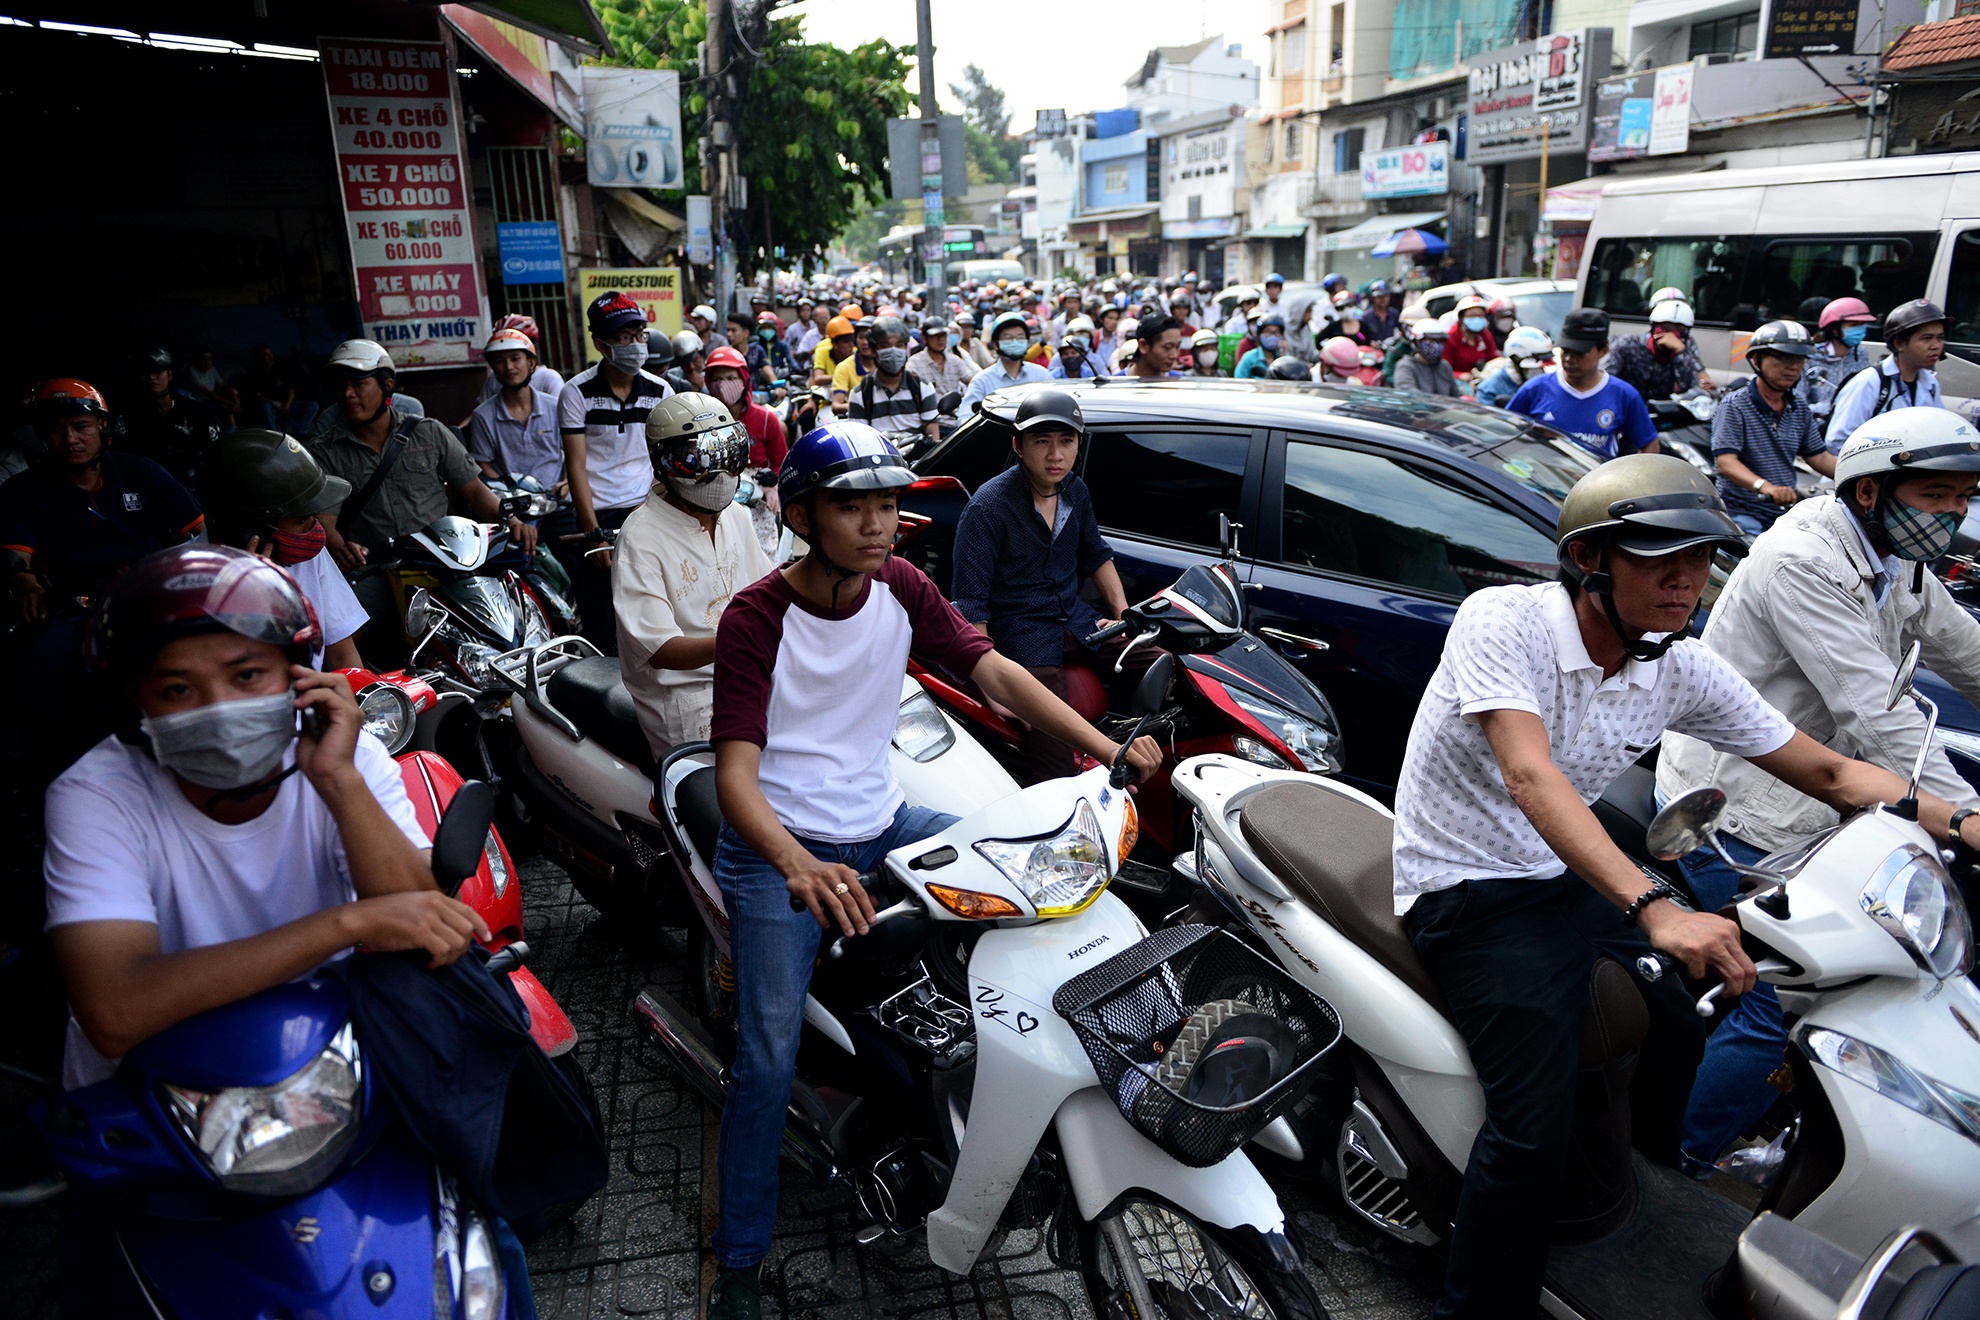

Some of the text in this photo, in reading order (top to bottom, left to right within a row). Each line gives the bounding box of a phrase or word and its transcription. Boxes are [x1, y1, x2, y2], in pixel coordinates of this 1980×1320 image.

[327, 47, 442, 69] TAXI ĐÊM
[348, 72, 430, 91] 18.000
[337, 102, 448, 127] XE 4 CHỖ
[353, 130, 442, 149] 40.000
[607, 127, 670, 138] MICHELIN
[346, 158, 456, 183] XE 7 CHỖ
[360, 187, 450, 206] 50.000
[356, 222, 378, 239] XE
[431, 214, 463, 237] CHỖ
[385, 242, 443, 260] 60.000
[373, 270, 462, 293] XE MÁY
[587, 274, 674, 288] BRIDGESTONE
[372, 317, 476, 342] THAY NHỚT
[1067, 934, 1110, 960] HONDA
